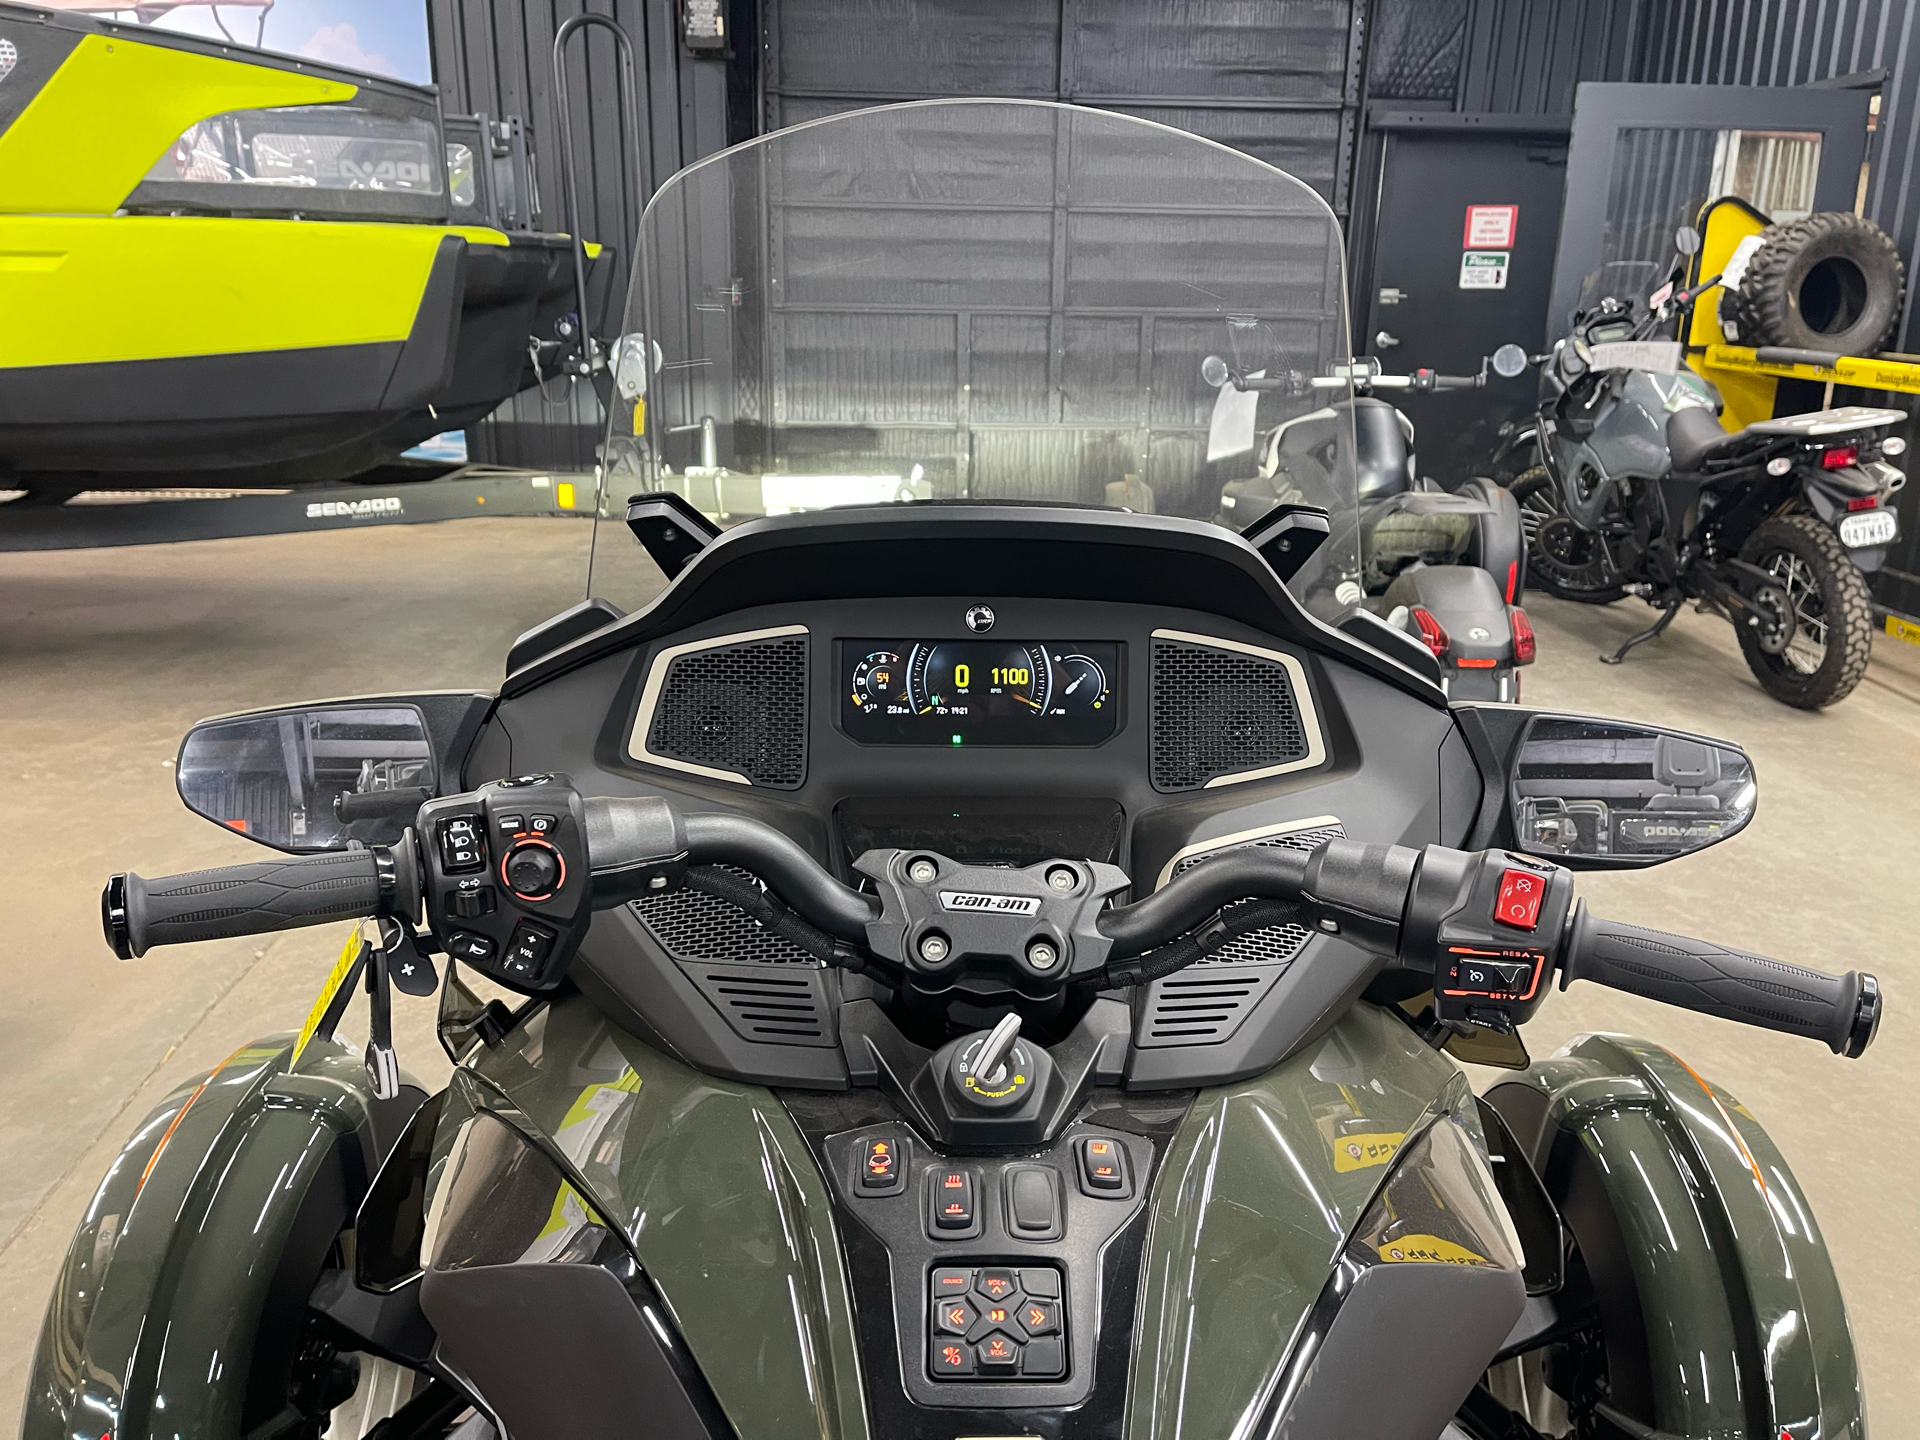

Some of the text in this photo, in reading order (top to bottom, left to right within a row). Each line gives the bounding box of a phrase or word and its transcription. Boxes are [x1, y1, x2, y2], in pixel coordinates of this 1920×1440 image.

[876, 672, 890, 683] 54
[954, 664, 970, 688] 0
[991, 667, 1029, 685] 1100
[931, 695, 939, 706] N
[952, 734, 962, 744] N
[952, 895, 1031, 911] can-am
[519, 946, 534, 959] VOL
[1489, 992, 1508, 1000] SET
[987, 1279, 1007, 1287] VOL+
